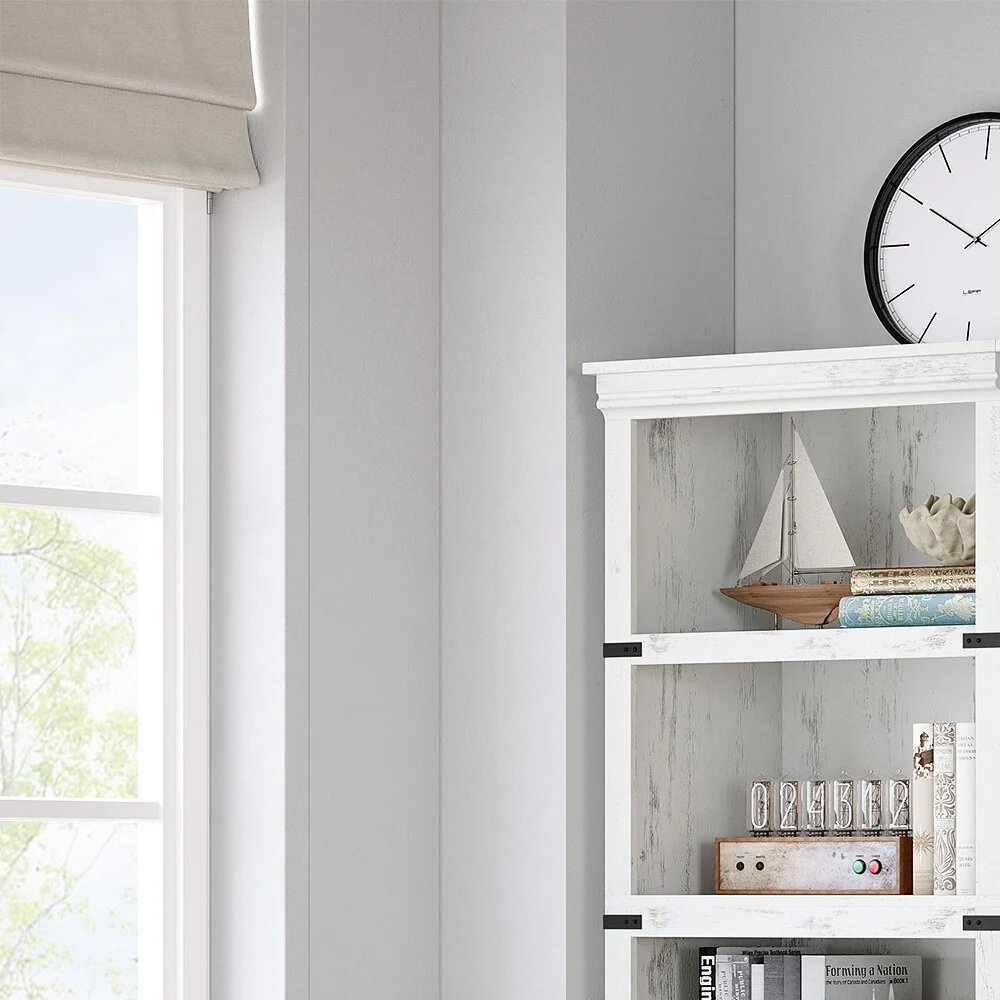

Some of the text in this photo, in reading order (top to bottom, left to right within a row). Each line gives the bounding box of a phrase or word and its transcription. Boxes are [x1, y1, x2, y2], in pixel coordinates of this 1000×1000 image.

[825, 963, 908, 978] Forming a Nation
